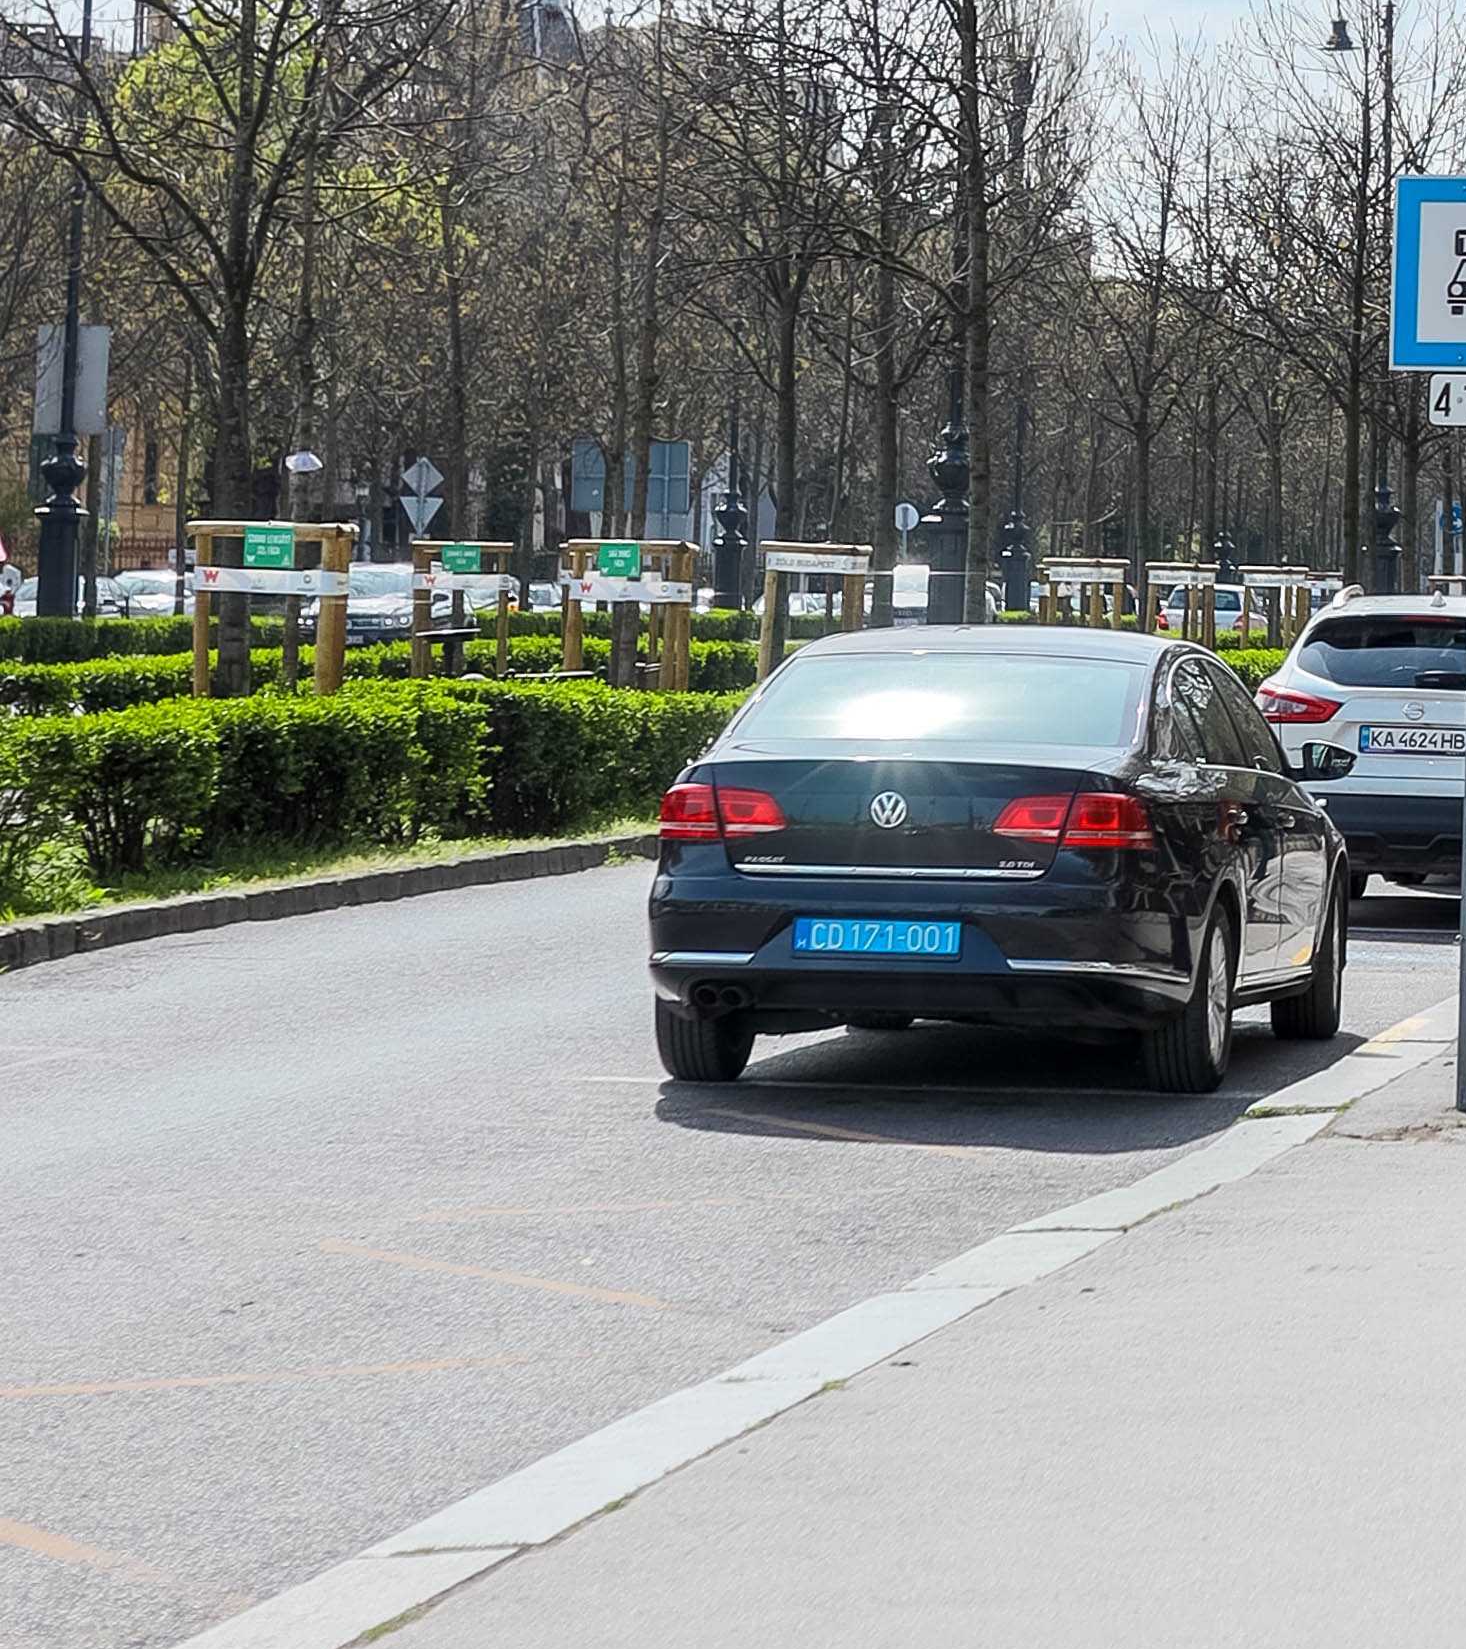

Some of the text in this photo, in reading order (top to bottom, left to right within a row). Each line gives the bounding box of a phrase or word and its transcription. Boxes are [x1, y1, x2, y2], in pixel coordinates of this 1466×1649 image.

[1433, 382, 1452, 418] 4
[1370, 730, 1466, 750] KA 4624 HB
